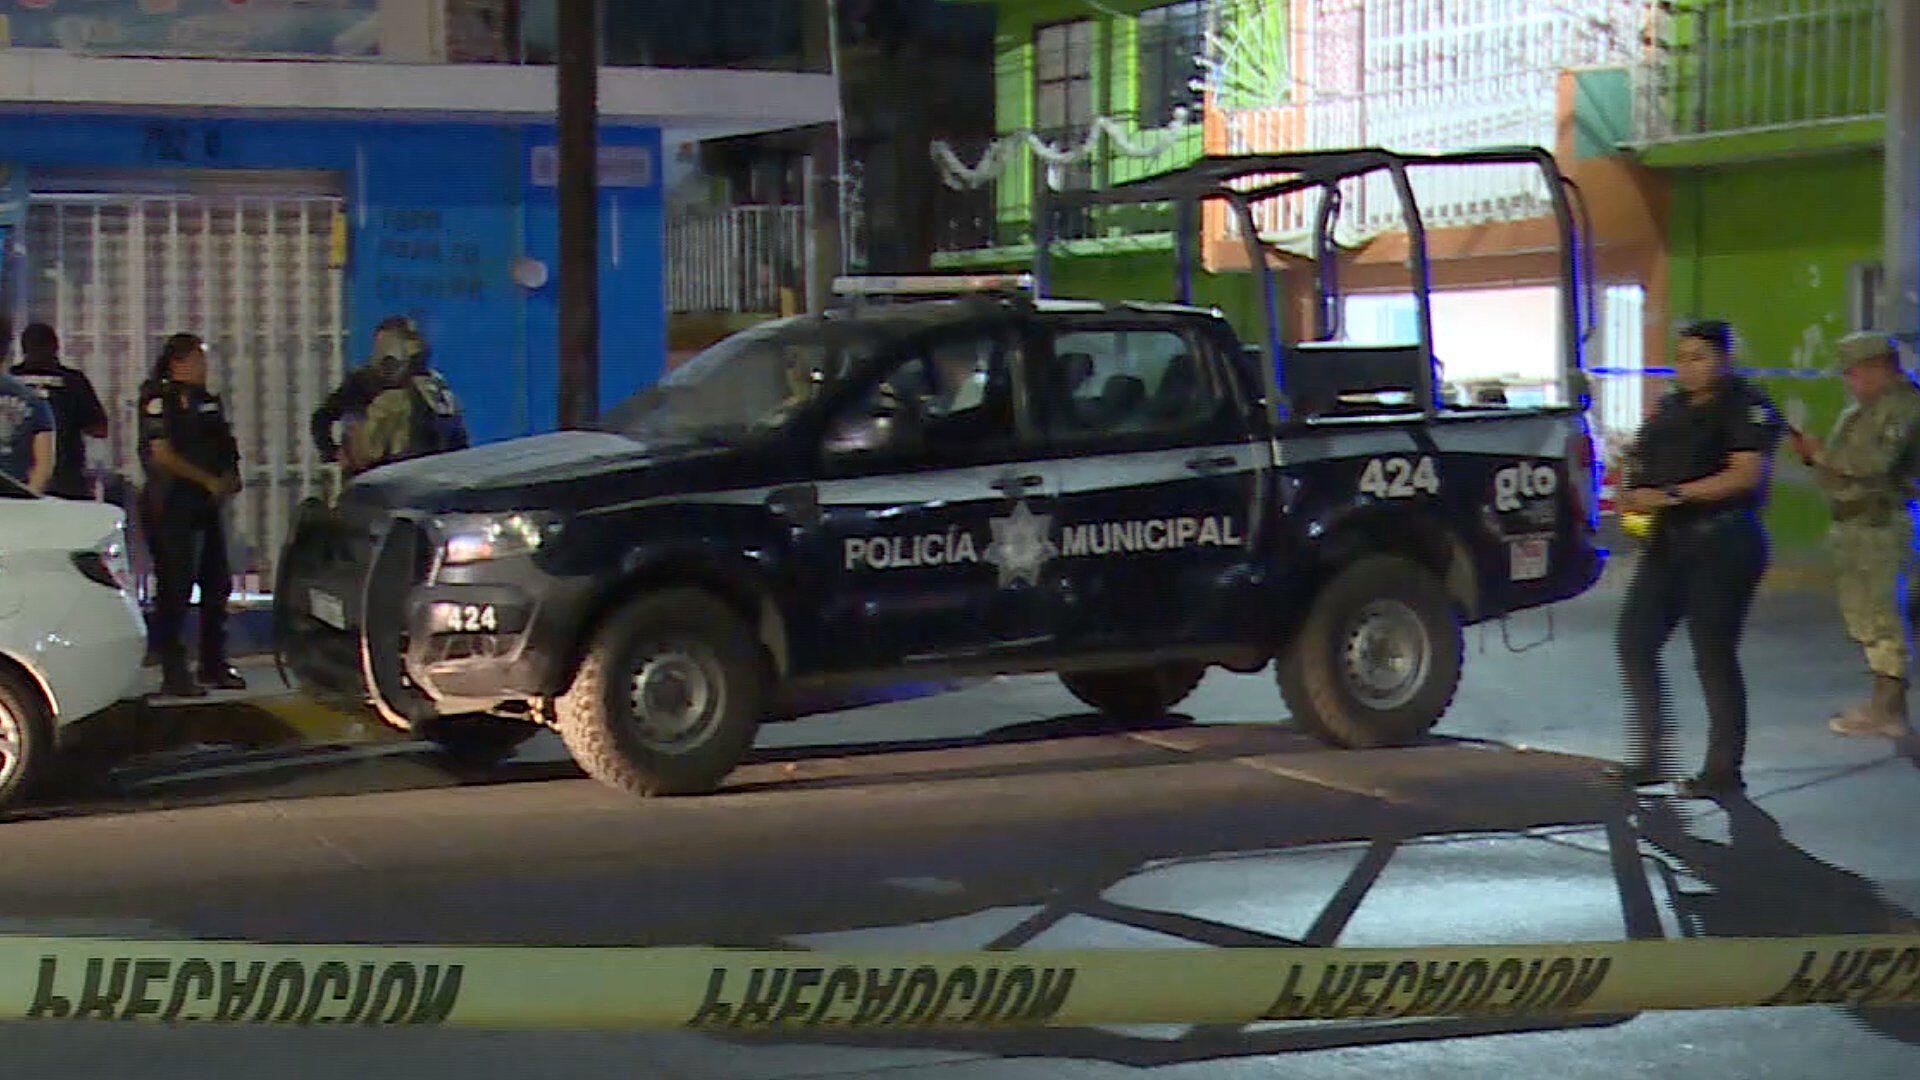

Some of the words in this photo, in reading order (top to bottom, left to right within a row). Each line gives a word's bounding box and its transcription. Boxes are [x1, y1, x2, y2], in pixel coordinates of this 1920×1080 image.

[1359, 456, 1440, 498] 424
[1494, 461, 1556, 511] gto
[843, 522, 979, 570] POLICÍA
[1062, 515, 1241, 557] MUNICIPAL
[447, 603, 497, 632] 424
